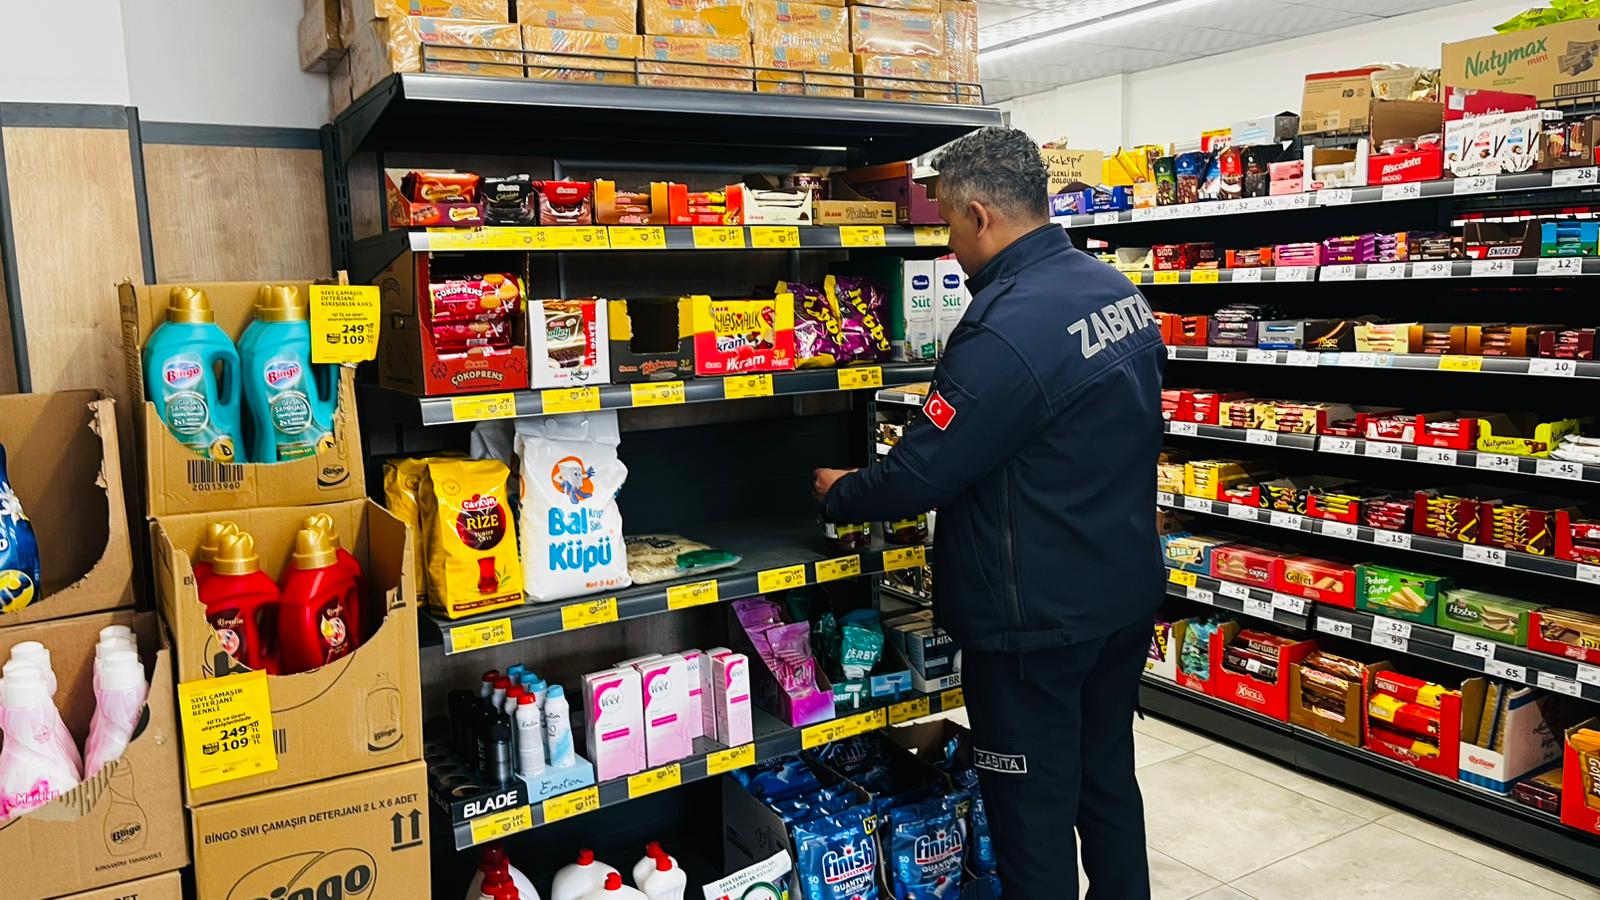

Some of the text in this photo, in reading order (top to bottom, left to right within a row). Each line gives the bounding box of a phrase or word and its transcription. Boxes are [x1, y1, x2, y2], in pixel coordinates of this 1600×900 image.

[1465, 36, 1547, 79] Nutymax
[1527, 54, 1549, 66] mini
[1382, 157, 1421, 175] Biscolata
[1382, 174, 1402, 182] MOOD
[1577, 169, 1592, 179] 28
[1473, 178, 1486, 187] 29
[1403, 186, 1416, 194] 56
[1264, 199, 1273, 207] 50
[1294, 197, 1305, 205] 65
[1489, 246, 1521, 256] SNICKERS
[1430, 263, 1443, 272] 49
[1490, 262, 1503, 271] 24
[1557, 259, 1571, 269] 12
[1248, 269, 1257, 277] 27
[1291, 269, 1300, 277] 27
[1341, 266, 1351, 274] 10
[1390, 265, 1396, 274] 9
[435, 287, 484, 300] ÇOKOPRENS
[912, 296, 931, 308] Süt
[942, 294, 961, 307] Süt
[342, 324, 364, 333] 249
[1067, 294, 1156, 359] ZABITA
[546, 327, 570, 340] alley
[343, 335, 364, 344] 109
[1554, 362, 1568, 371] 10
[166, 367, 200, 383] Bingo
[267, 366, 299, 384] Bingo
[451, 370, 504, 386] ÇOKOPRENS
[1339, 441, 1350, 449] 27
[1483, 440, 1514, 449] Nutymax
[1385, 446, 1397, 454] 30
[1438, 453, 1449, 461] 16
[1495, 457, 1509, 466] 34
[323, 466, 344, 475] Bingo
[1560, 464, 1574, 473] 45
[466, 515, 499, 530] RİZE
[548, 507, 588, 536] Bal
[1288, 517, 1297, 525] 16
[1346, 527, 1352, 535] 9
[1392, 535, 1403, 543] 15
[549, 536, 612, 573] Küpü
[1486, 551, 1499, 559] 16
[1287, 572, 1312, 586] Gofret
[1289, 599, 1299, 607] 34
[1392, 623, 1403, 632] 52
[1392, 636, 1403, 645] 99
[1475, 642, 1488, 652] 54
[845, 648, 878, 661] DERBY
[1506, 669, 1519, 678] 65
[650, 681, 669, 694] Veet
[209, 688, 243, 700] ÇAMAŞIR
[192, 697, 233, 710] DETERJANI
[601, 694, 621, 708] Veet
[192, 706, 220, 716] RENKLİ
[231, 712, 246, 720] üzeri
[220, 726, 247, 741] 249
[222, 737, 249, 752] 109
[977, 753, 1020, 770] ZABITA
[540, 778, 584, 795] Emotion
[463, 790, 518, 818] BLADE
[205, 831, 238, 845] BİNGO
[240, 826, 259, 837] SIVI
[262, 815, 307, 835] ÇAMAŞIR
[309, 806, 362, 823] DETERJANI
[371, 802, 377, 810] L
[379, 800, 386, 809] X
[387, 799, 393, 807] 6
[394, 793, 418, 806] ADET
[111, 823, 141, 842] Bingo
[916, 830, 961, 862] finish
[823, 840, 873, 880] finish
[899, 856, 910, 864] 50
[808, 876, 819, 884] 50
